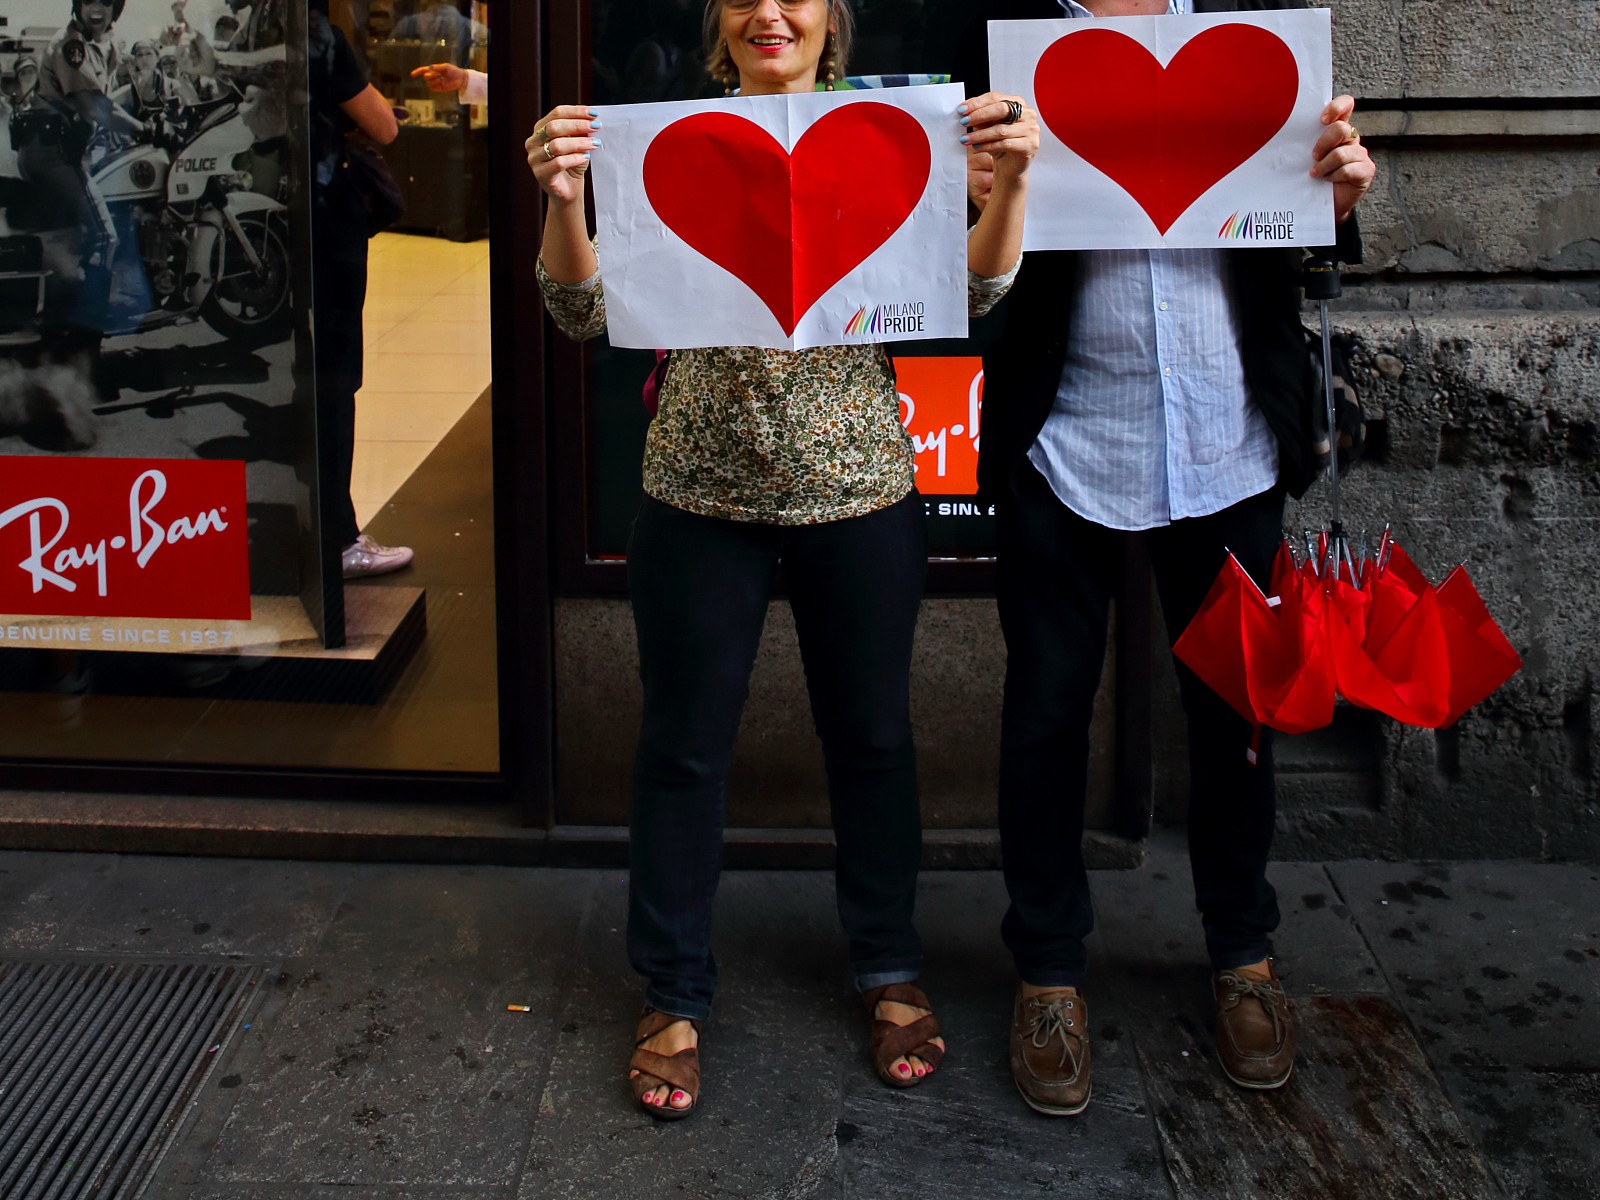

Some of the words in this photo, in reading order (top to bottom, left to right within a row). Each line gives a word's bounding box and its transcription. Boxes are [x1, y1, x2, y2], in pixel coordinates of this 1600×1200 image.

[175, 157, 218, 173] POLICE
[1254, 210, 1294, 224] MILANO
[1255, 223, 1294, 240] PRIDE
[883, 301, 925, 317] MILANO
[884, 315, 925, 335] PRIDE
[102, 628, 170, 644] SINCE
[180, 630, 233, 646] 1937
